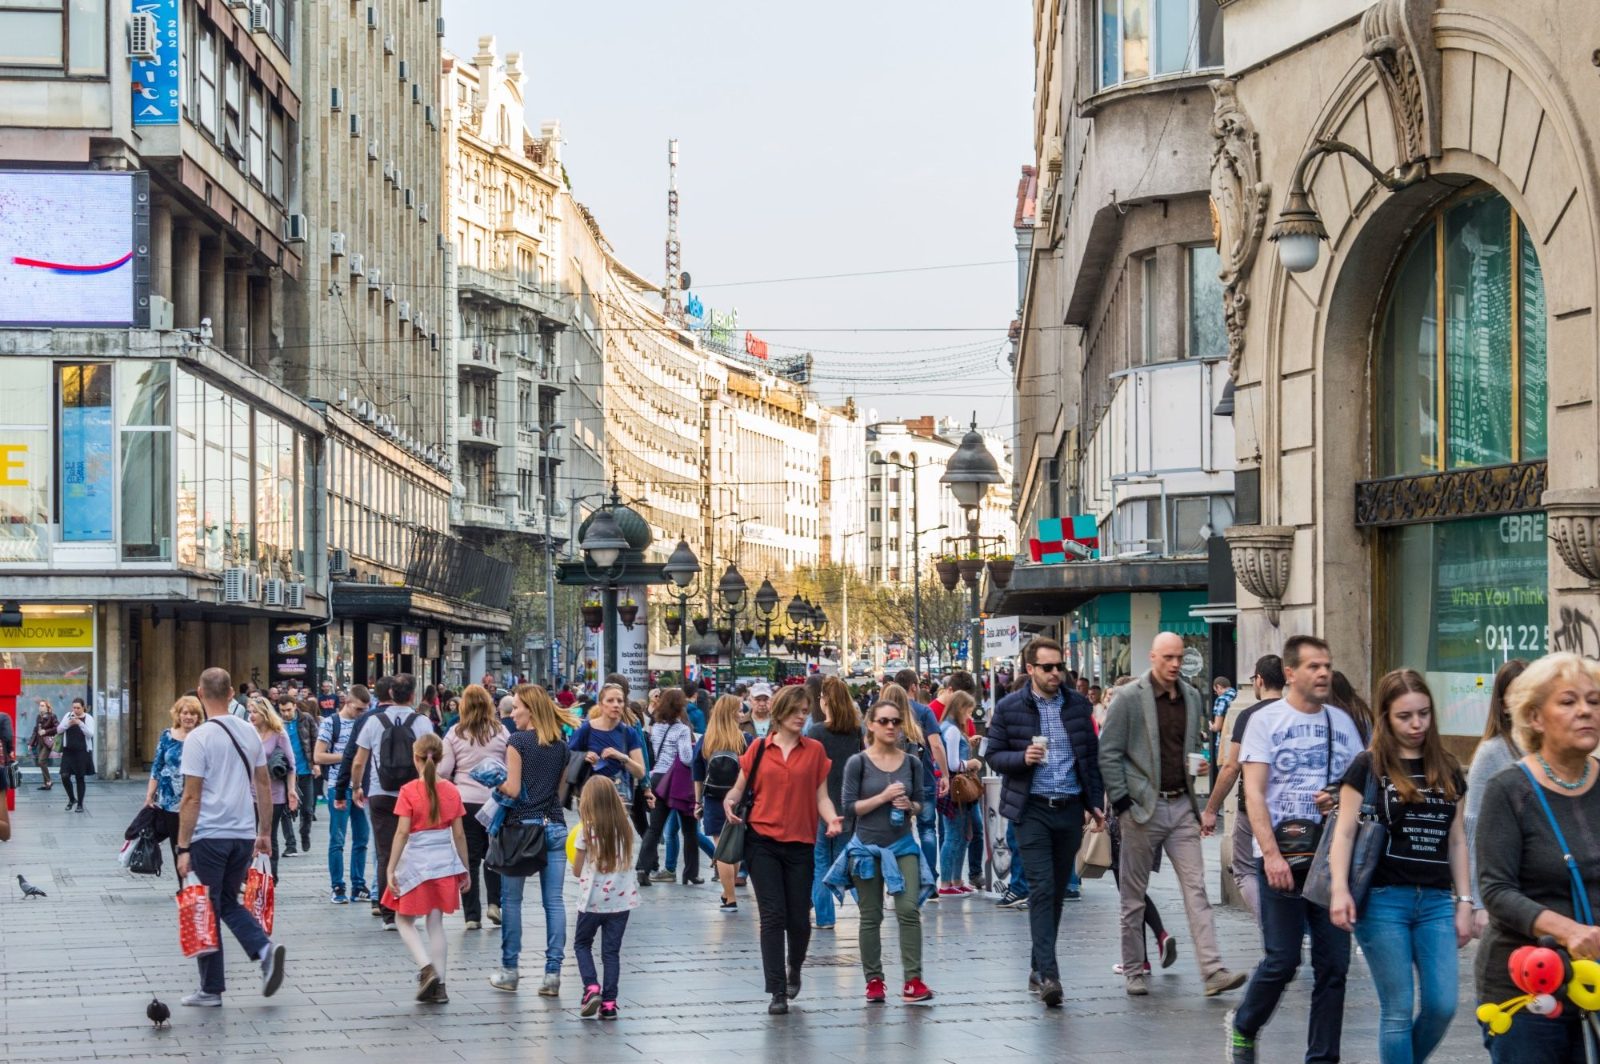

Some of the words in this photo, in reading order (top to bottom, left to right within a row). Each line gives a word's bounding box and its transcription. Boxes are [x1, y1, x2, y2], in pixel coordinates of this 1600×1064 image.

[1500, 514, 1545, 543] CBRE
[1452, 587, 1482, 606] When
[1485, 588, 1510, 606] You
[1513, 587, 1545, 605] Think
[2, 627, 56, 638] WINDOW
[1485, 625, 1515, 650] 011
[1518, 625, 1539, 650] 22
